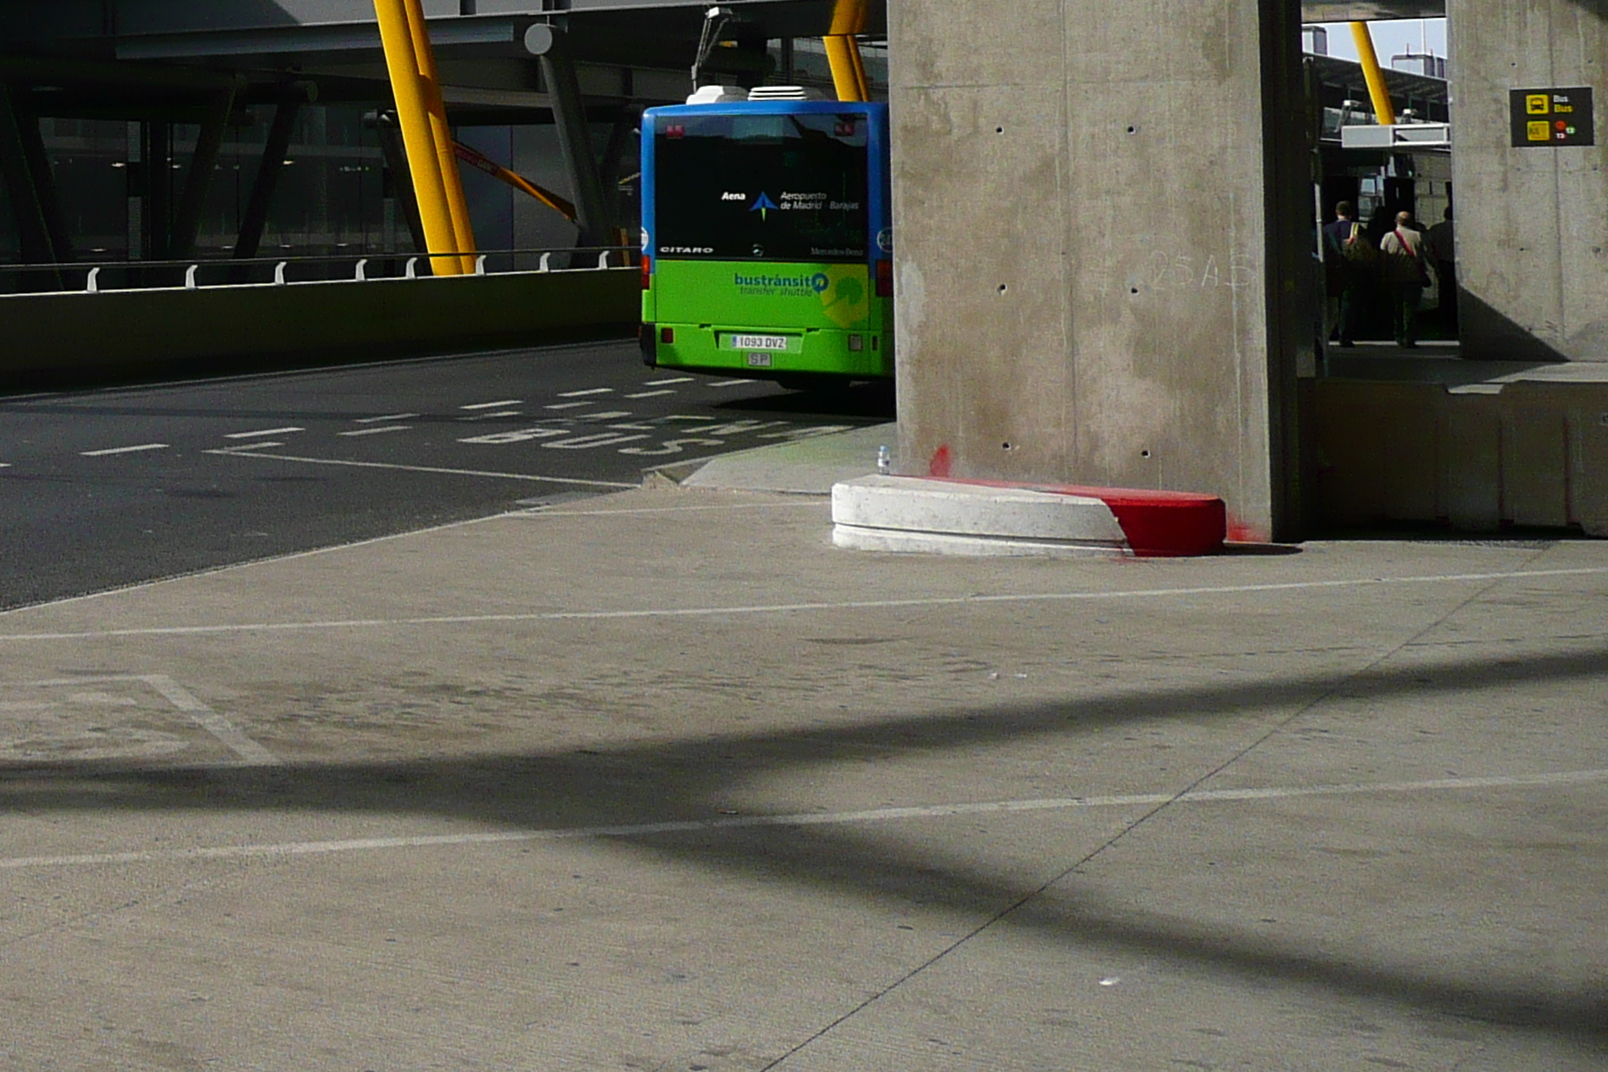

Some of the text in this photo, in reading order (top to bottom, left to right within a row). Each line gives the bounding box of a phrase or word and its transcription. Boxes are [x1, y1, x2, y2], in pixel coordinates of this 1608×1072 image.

[721, 191, 747, 201] Aena
[780, 190, 828, 201] Aeropuerto
[780, 201, 792, 210] de
[792, 200, 822, 210] Madrid
[829, 201, 860, 211] Barajas
[659, 245, 714, 254] CITARO
[740, 286, 813, 297] transfer shuttle
[740, 337, 784, 348] 1093 DVZ
[455, 427, 727, 456] BUS
